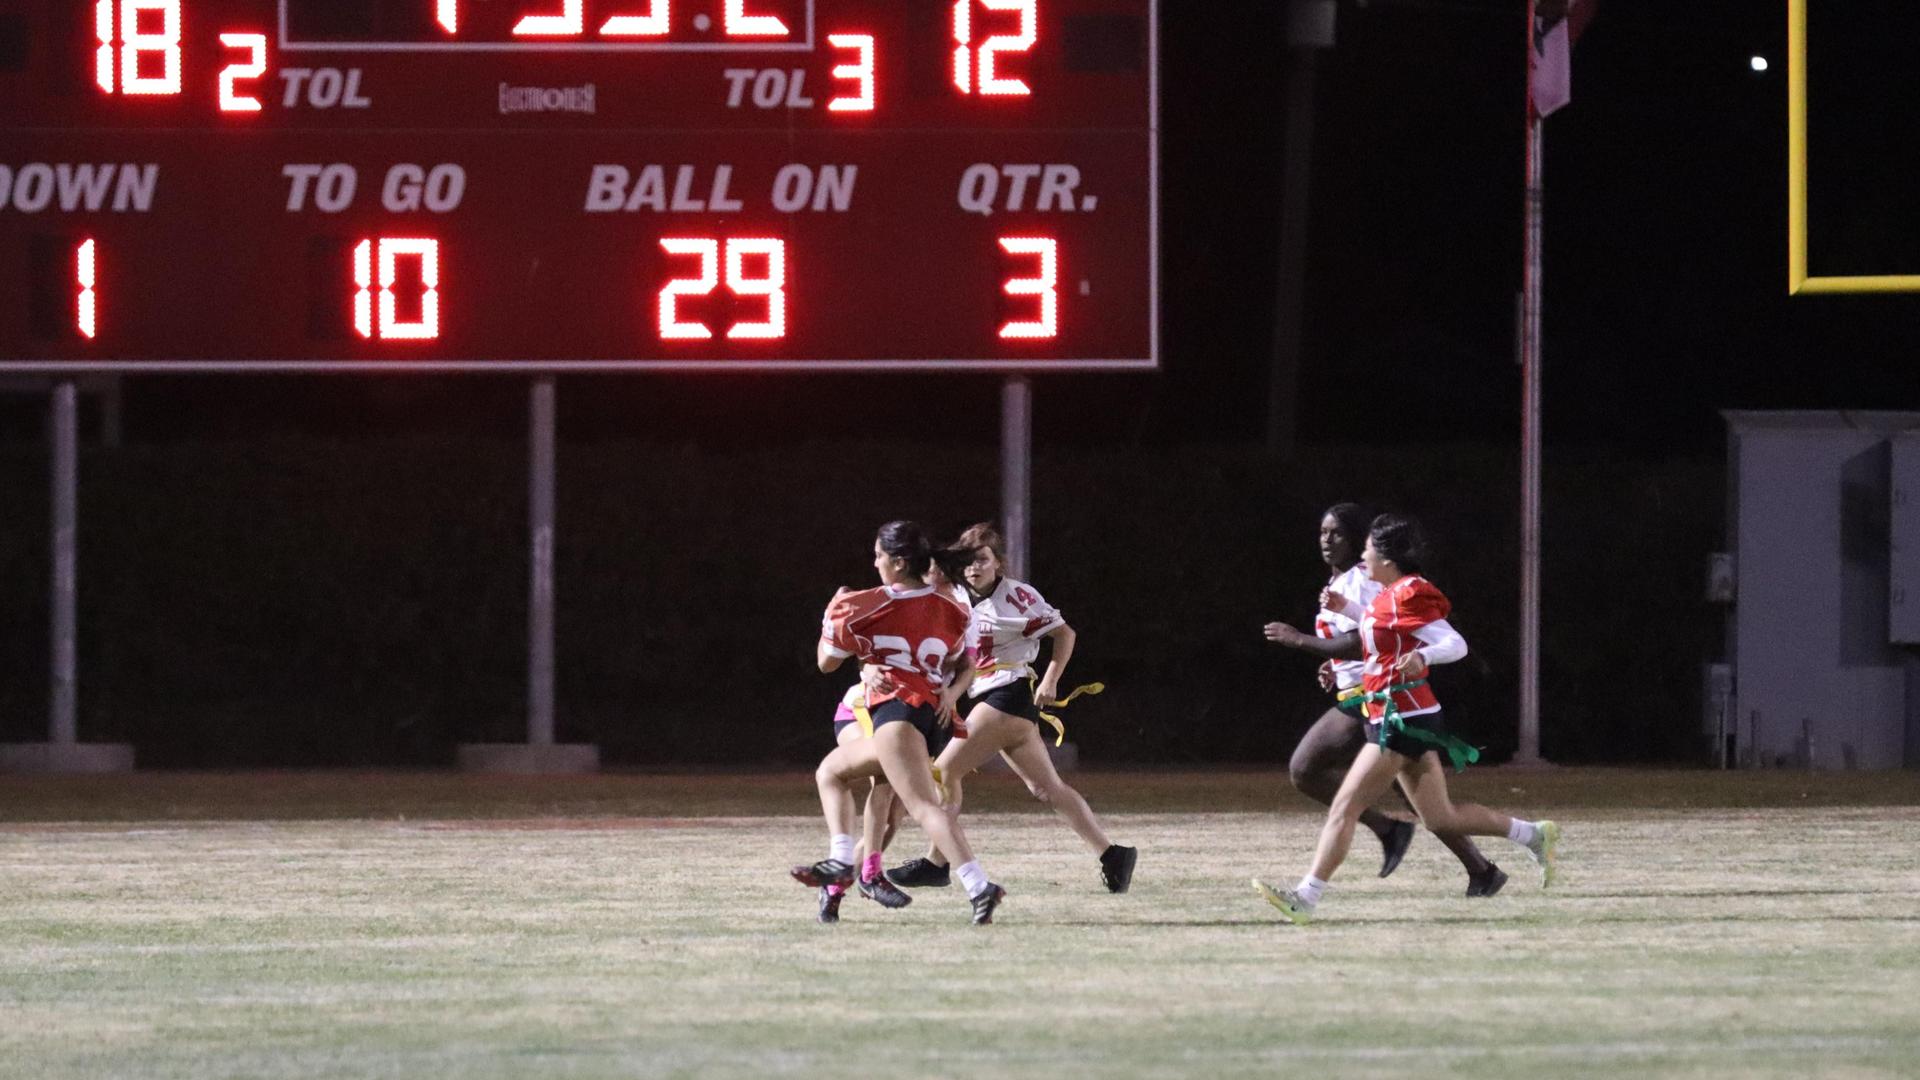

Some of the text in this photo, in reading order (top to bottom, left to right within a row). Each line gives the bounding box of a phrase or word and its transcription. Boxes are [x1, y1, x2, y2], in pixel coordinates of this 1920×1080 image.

[96, 0, 182, 95] 18
[219, 33, 267, 111] 2
[827, 34, 874, 111] 3
[954, 0, 1037, 95] 12
[280, 68, 371, 108] TOL
[724, 68, 814, 108] TOL
[282, 163, 466, 212] TO GO
[584, 163, 858, 212] BALL ON
[957, 163, 1098, 216] QTR.
[77, 238, 95, 338] 1
[354, 238, 439, 339] 10
[658, 238, 785, 339] 29
[998, 237, 1057, 338] 3
[1006, 586, 1037, 614] 14
